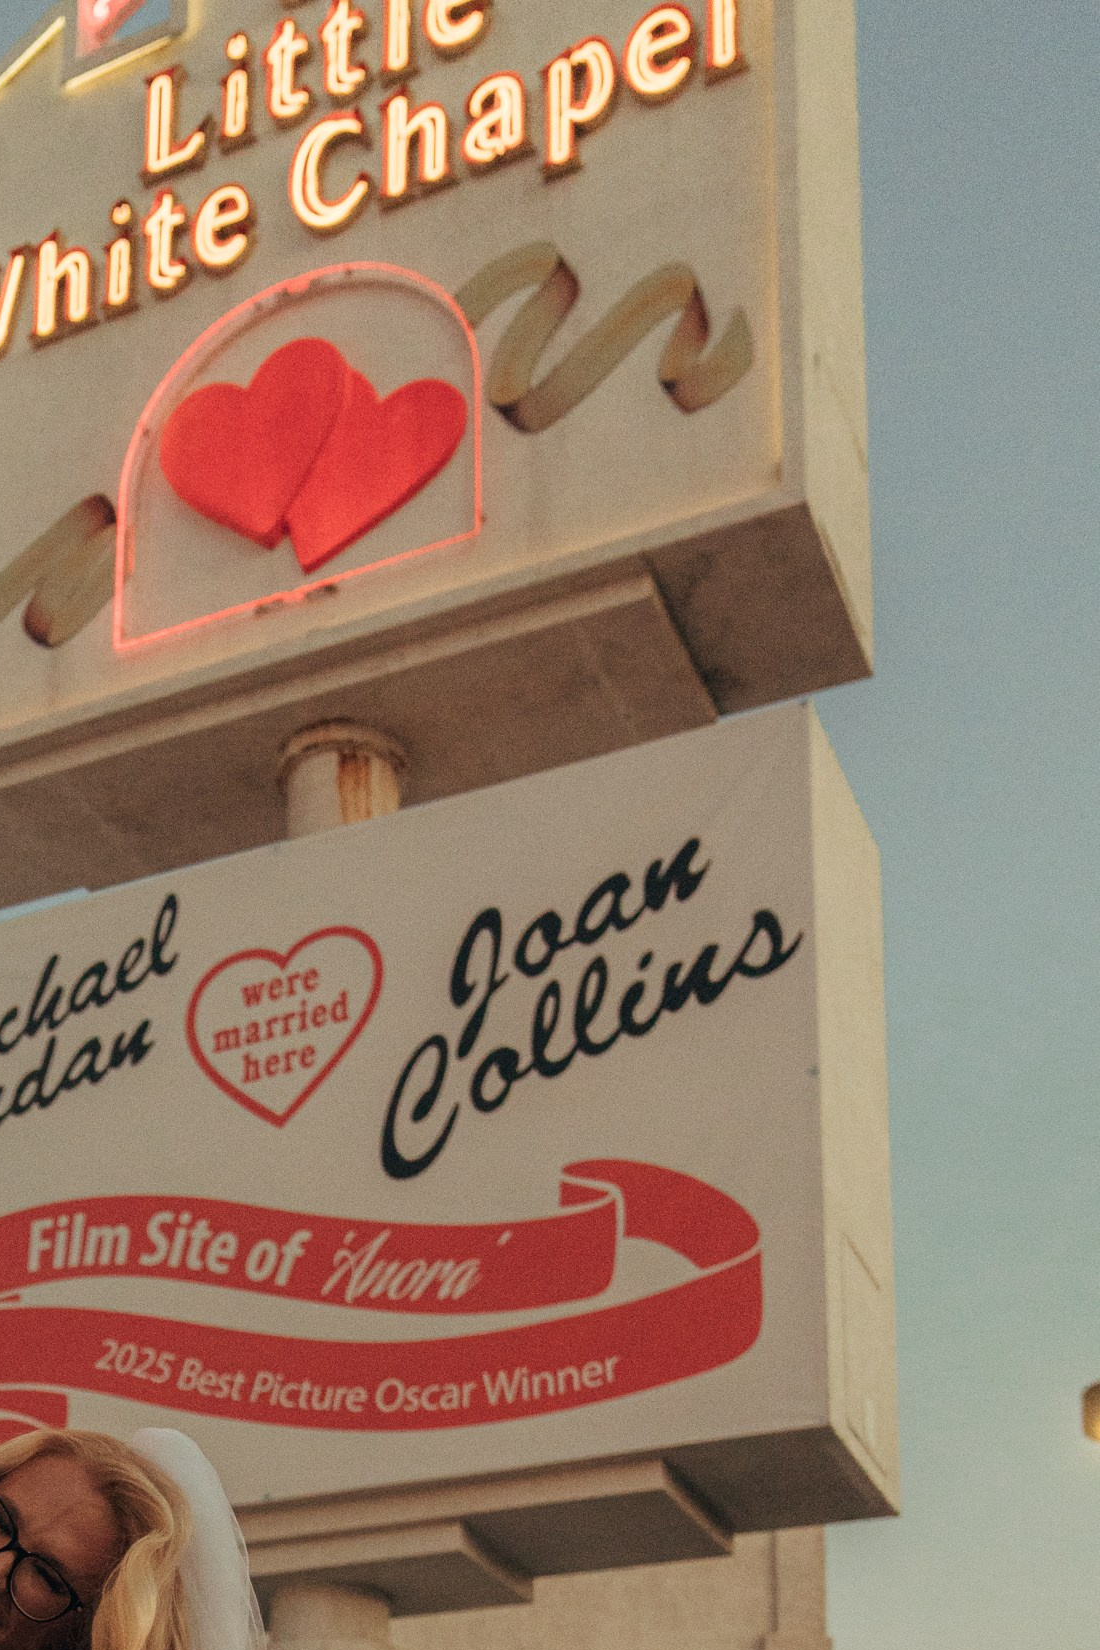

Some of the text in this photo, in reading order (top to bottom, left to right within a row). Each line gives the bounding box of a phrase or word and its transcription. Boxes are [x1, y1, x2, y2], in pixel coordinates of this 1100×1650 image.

[142, 0, 489, 184] Little
[288, 0, 745, 232] Chapel
[450, 837, 712, 1059] Joan
[213, 990, 349, 1053] married
[241, 968, 319, 1008] were
[242, 1044, 316, 1084] here
[380, 909, 804, 1180] Collins
[26, 1212, 131, 1273] Film
[139, 1211, 240, 1275] Site
[245, 1229, 313, 1287] of
[95, 1338, 620, 1413] 2025 Best Picture Oscar Winner
